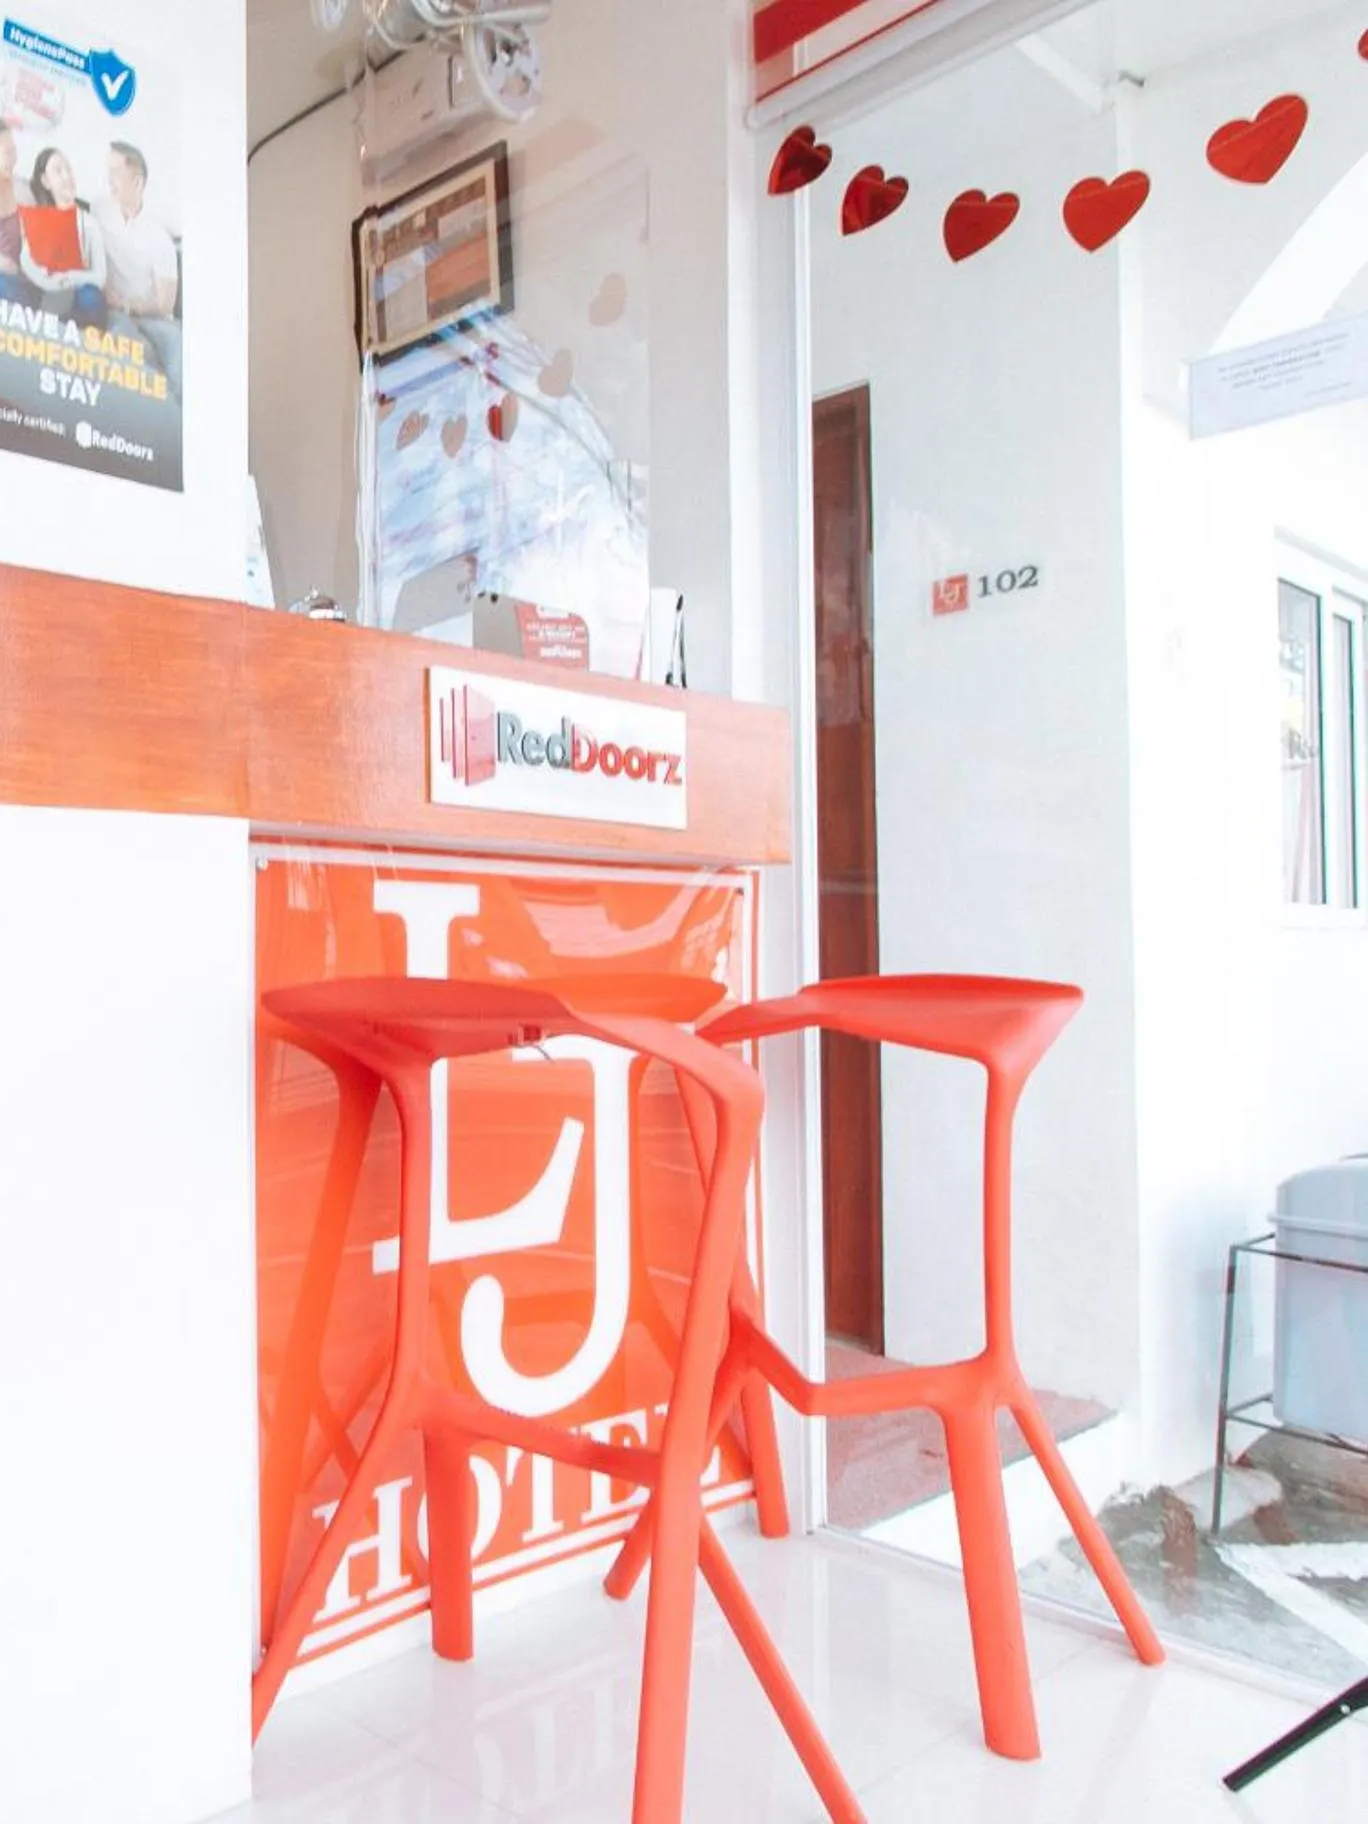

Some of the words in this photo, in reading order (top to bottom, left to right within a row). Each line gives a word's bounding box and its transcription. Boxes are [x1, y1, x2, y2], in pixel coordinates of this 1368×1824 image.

[63, 319, 81, 348] A
[84, 325, 144, 366] SAFE
[40, 369, 101, 406] STAY
[977, 564, 1039, 598] 102
[497, 710, 683, 786] RedDoorz
[312, 1403, 721, 1624] HOTE
